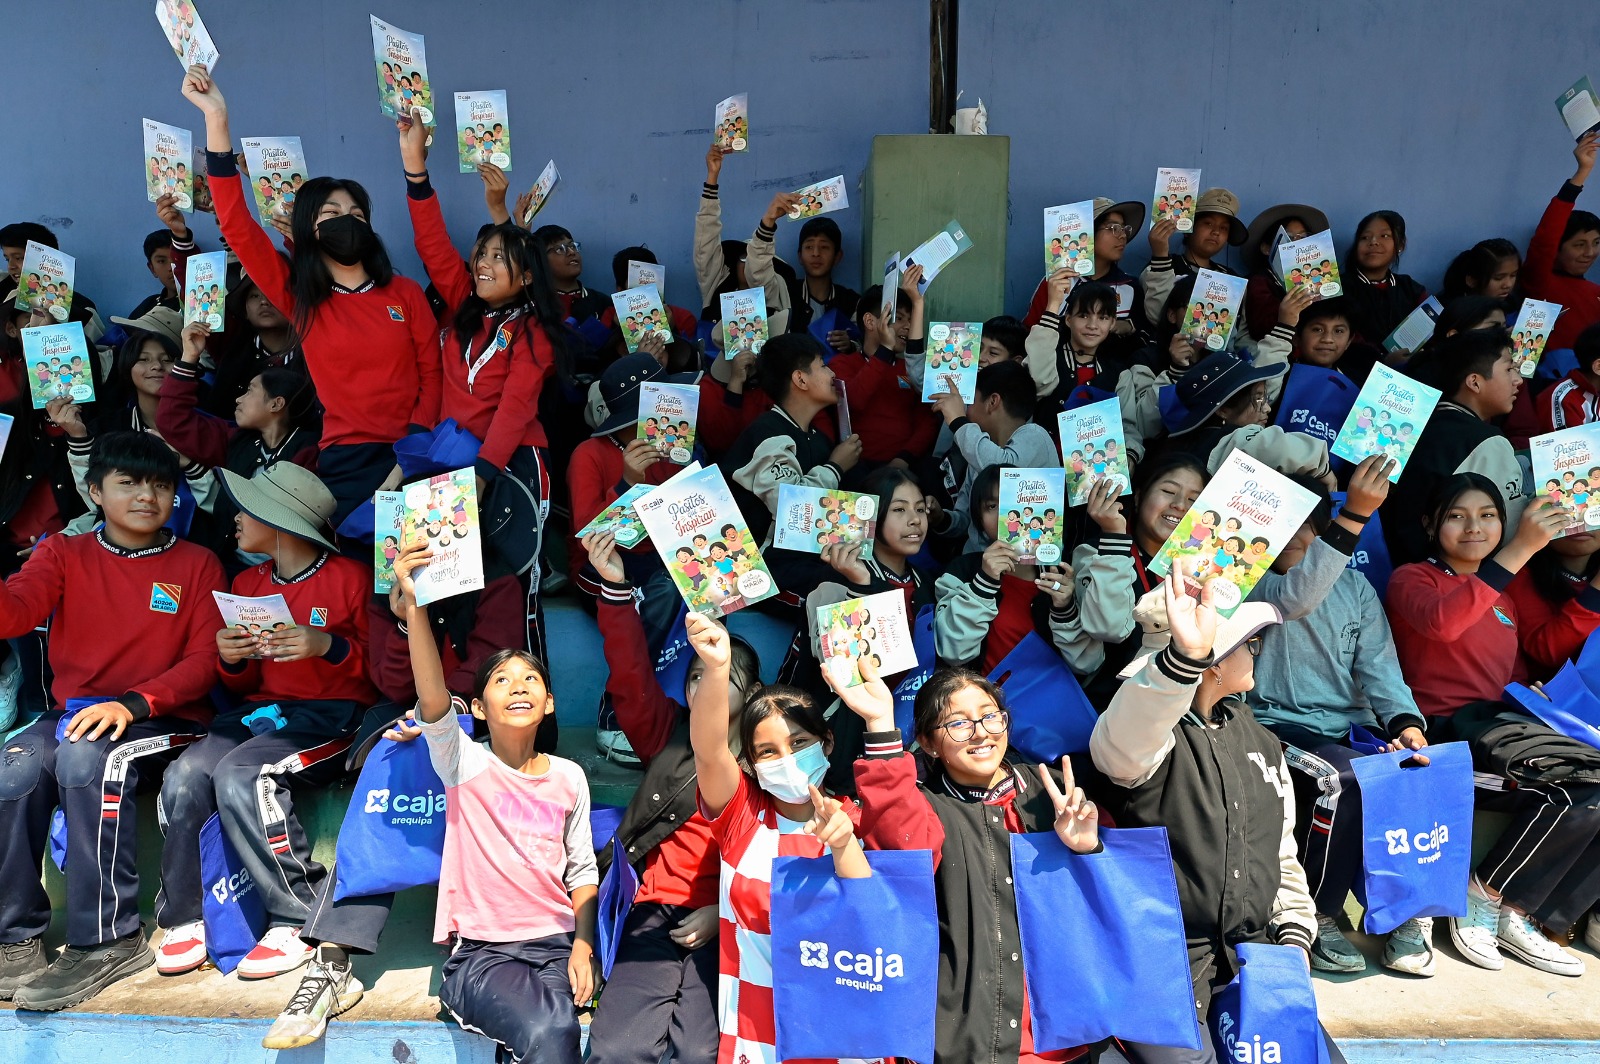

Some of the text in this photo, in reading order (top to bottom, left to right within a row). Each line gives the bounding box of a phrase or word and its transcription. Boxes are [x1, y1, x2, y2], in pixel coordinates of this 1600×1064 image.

[386, 35, 409, 51] Pasitos
[386, 48, 412, 64] Inspiran
[470, 101, 492, 111] Pasitos
[470, 111, 495, 121] Inspiran
[156, 133, 177, 145] Pasitos
[155, 144, 179, 156] Inspiran
[262, 148, 287, 160] Pasitos
[263, 161, 291, 171] Inspiran
[1168, 176, 1187, 184] Pasitos
[1058, 212, 1080, 225] Pasitos
[1058, 222, 1080, 233] Inspiran
[1295, 244, 1318, 256] Pasitos
[41, 254, 63, 267] Pasitos
[1295, 251, 1321, 264] Inspiran
[39, 263, 64, 277] Inspiran
[195, 262, 212, 273] Pasitos
[194, 273, 214, 283] Inspiran
[1208, 280, 1228, 293] Pasitos
[626, 293, 647, 305] Pasitos
[1204, 291, 1227, 303] Inspiran
[628, 302, 651, 312] Inspiran
[733, 298, 753, 309] Pasitos
[733, 306, 755, 317] Inspiran
[41, 334, 68, 346] Pasitos
[43, 345, 72, 357] Inspiran
[1382, 371, 1393, 379] caja
[1385, 382, 1416, 403] Pasitos
[657, 394, 682, 405] Pasitos
[1378, 392, 1413, 415] Inspiran
[655, 404, 683, 415] Inspiran
[1076, 415, 1103, 432] Pasitos
[1308, 416, 1337, 441] caja
[1076, 427, 1106, 442] Inspiran
[1554, 440, 1588, 458] Pasitos
[1554, 452, 1590, 470] Inspiran
[1241, 462, 1256, 474] caja
[1019, 480, 1046, 492] Pasitos
[1016, 493, 1048, 504] Inspiran
[1239, 480, 1284, 509] Pasitos
[648, 498, 664, 509] caja
[668, 493, 706, 521] Pasitos
[1226, 495, 1272, 526] Inspiran
[674, 508, 717, 537] Inspiran
[787, 504, 800, 531] Pasitos
[799, 503, 814, 534] Inspiran
[744, 578, 764, 589] MARÍA
[393, 790, 447, 817] caja
[391, 817, 432, 826] arequipa
[1414, 821, 1449, 852] caja
[834, 947, 904, 983] caja
[835, 977, 883, 992] arequipa
